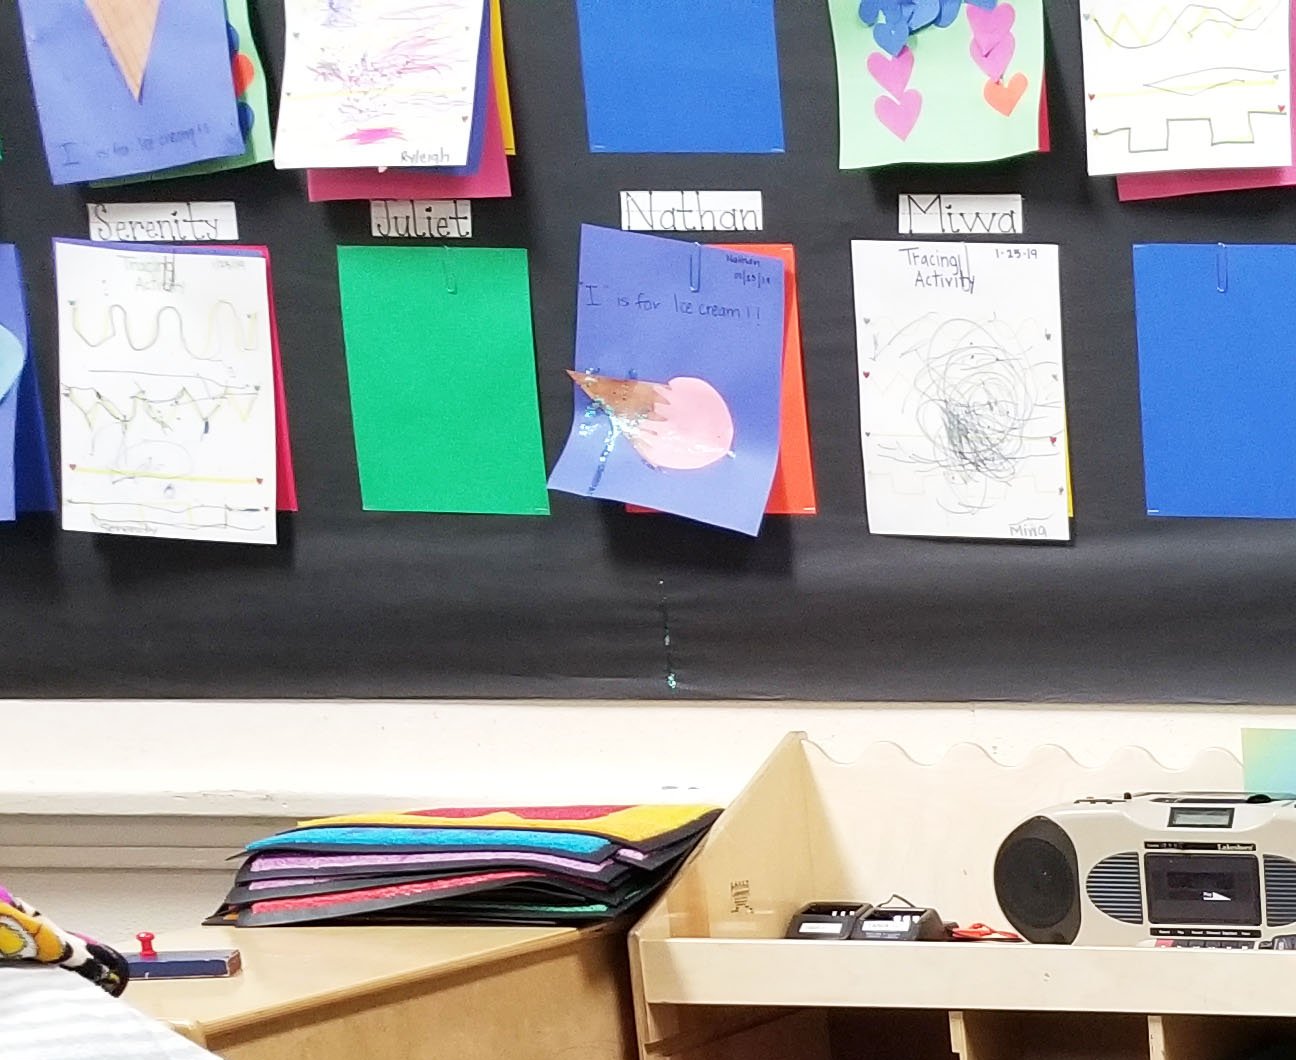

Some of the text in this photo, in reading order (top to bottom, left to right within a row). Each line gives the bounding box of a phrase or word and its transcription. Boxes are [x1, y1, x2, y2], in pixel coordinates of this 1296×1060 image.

[94, 201, 218, 241] Serenity
[377, 200, 470, 239] Juliet
[626, 191, 759, 231] Nathan
[907, 194, 1017, 235] Miwa
[898, 247, 960, 276] Tracing
[914, 269, 976, 294] Activity
[617, 297, 630, 307] is
[635, 293, 662, 312] for
[674, 293, 694, 316] Ice
